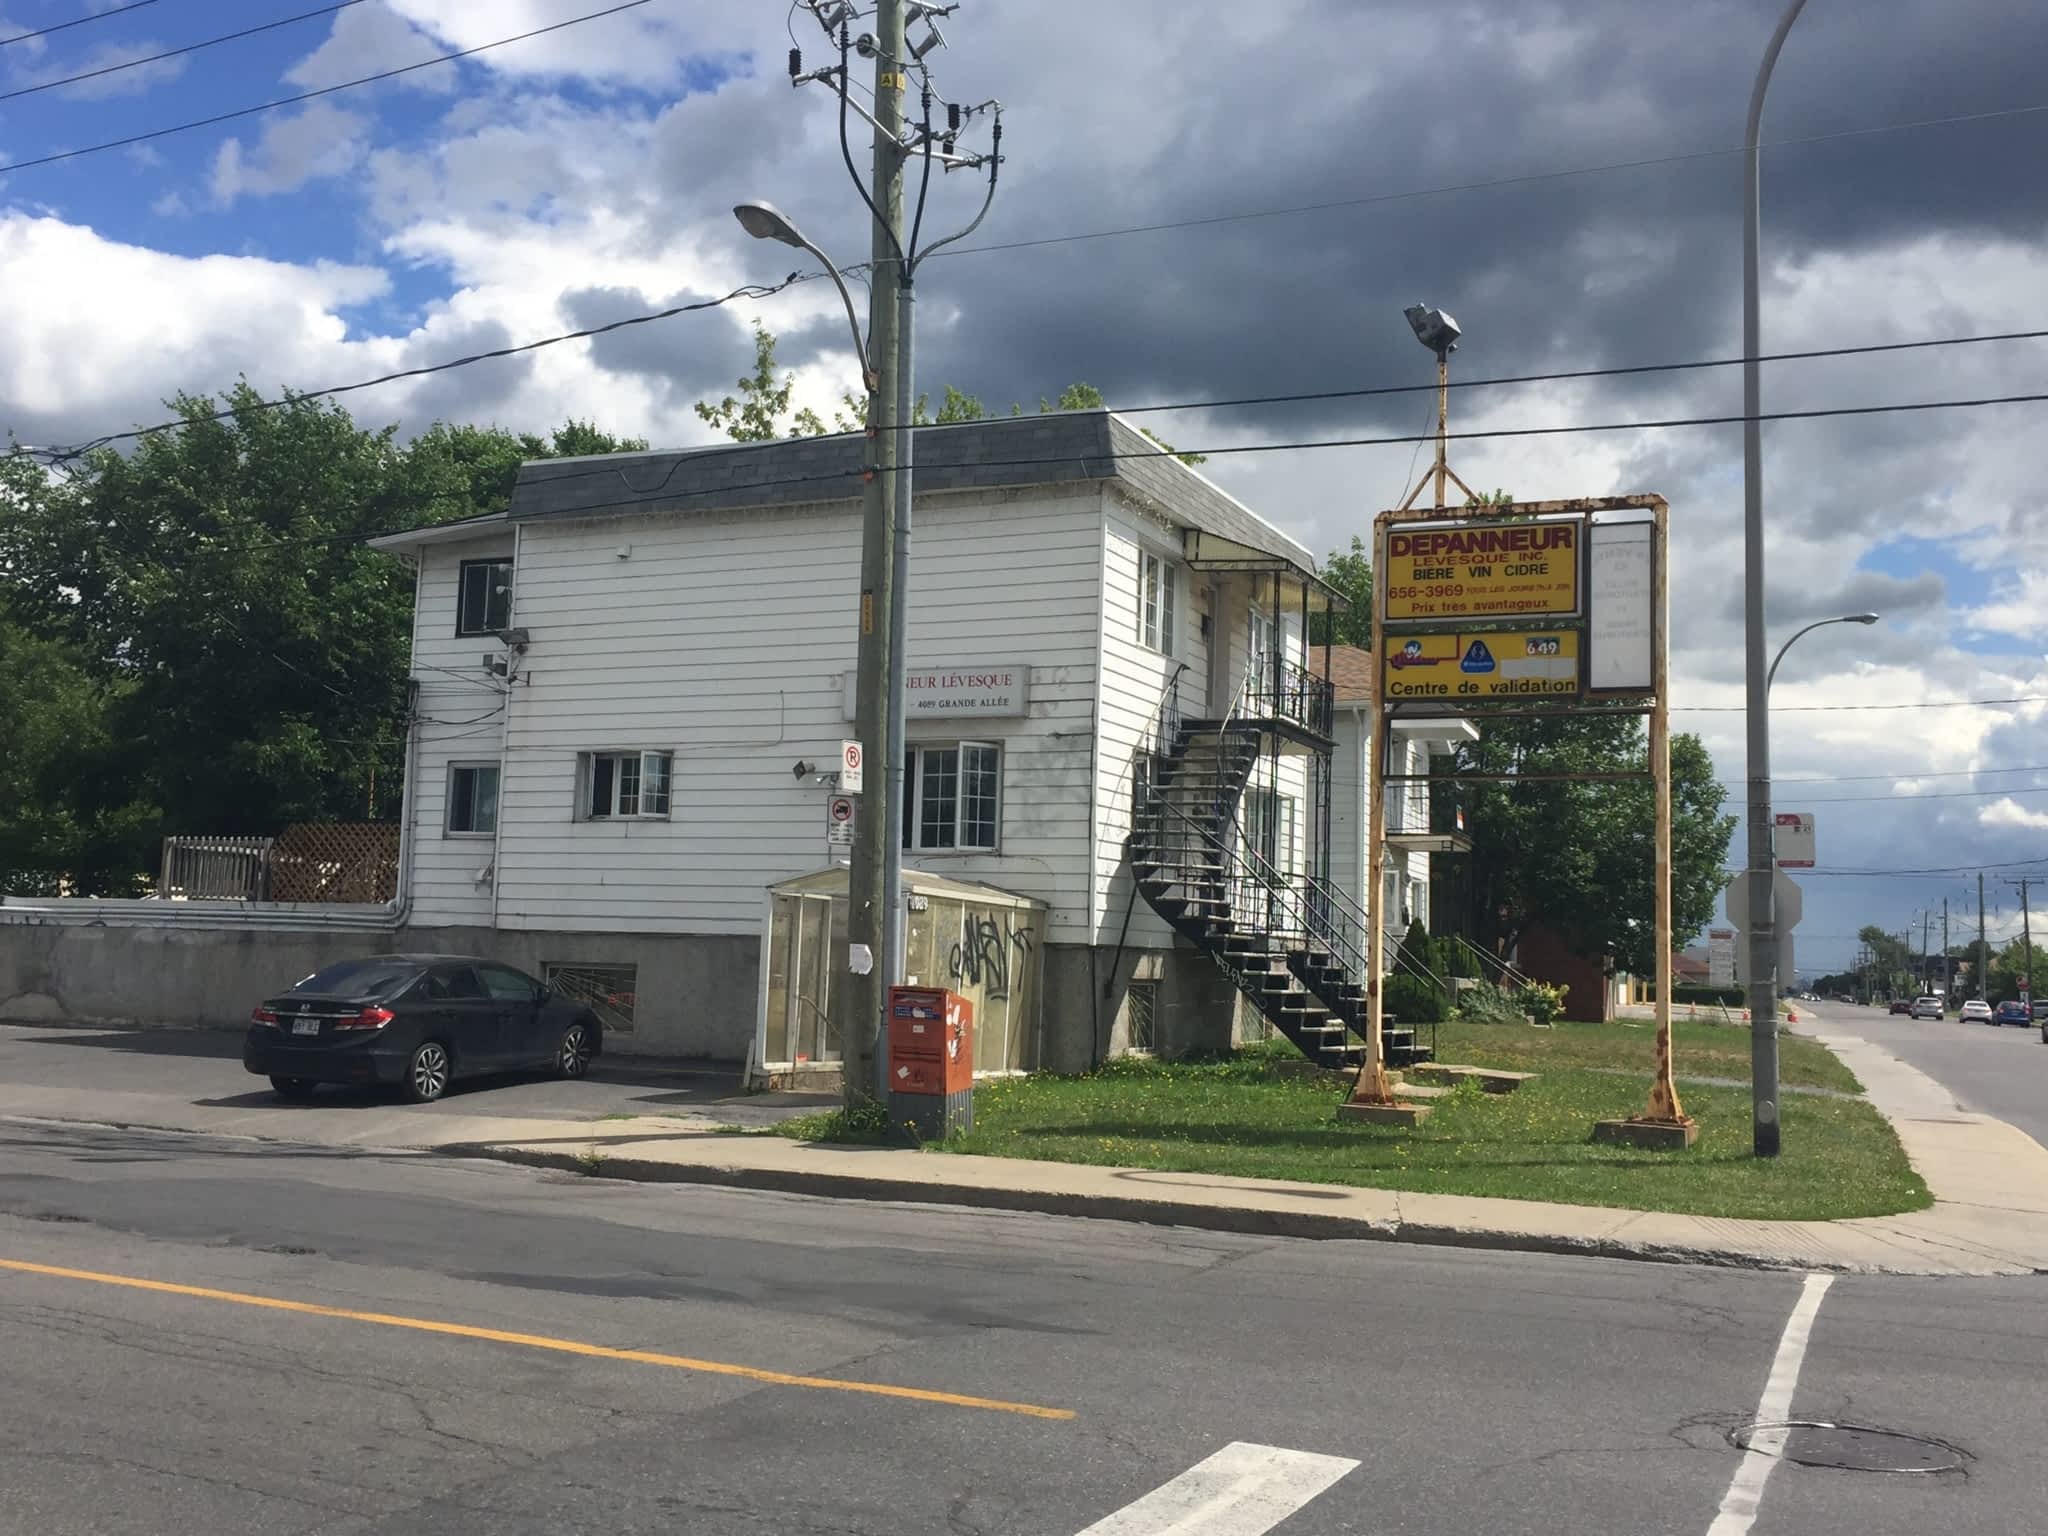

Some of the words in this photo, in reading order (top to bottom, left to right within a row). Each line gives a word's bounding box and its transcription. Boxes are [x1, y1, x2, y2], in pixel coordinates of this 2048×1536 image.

[1390, 526, 1572, 557] DEPANNEUR
[1413, 553, 1510, 567] LEVESQUE
[1467, 565, 1492, 578] VIN
[1503, 563, 1549, 577] CIDRE
[1389, 583, 1463, 599] 656-3969
[1411, 601, 1435, 613] Prix
[1473, 598, 1548, 611] avantageux
[942, 671, 1012, 690] LÉVESQUE
[1390, 681, 1448, 696] Centre
[1457, 680, 1480, 694] de
[1489, 678, 1576, 694] validation
[938, 697, 976, 709] GRANDE
